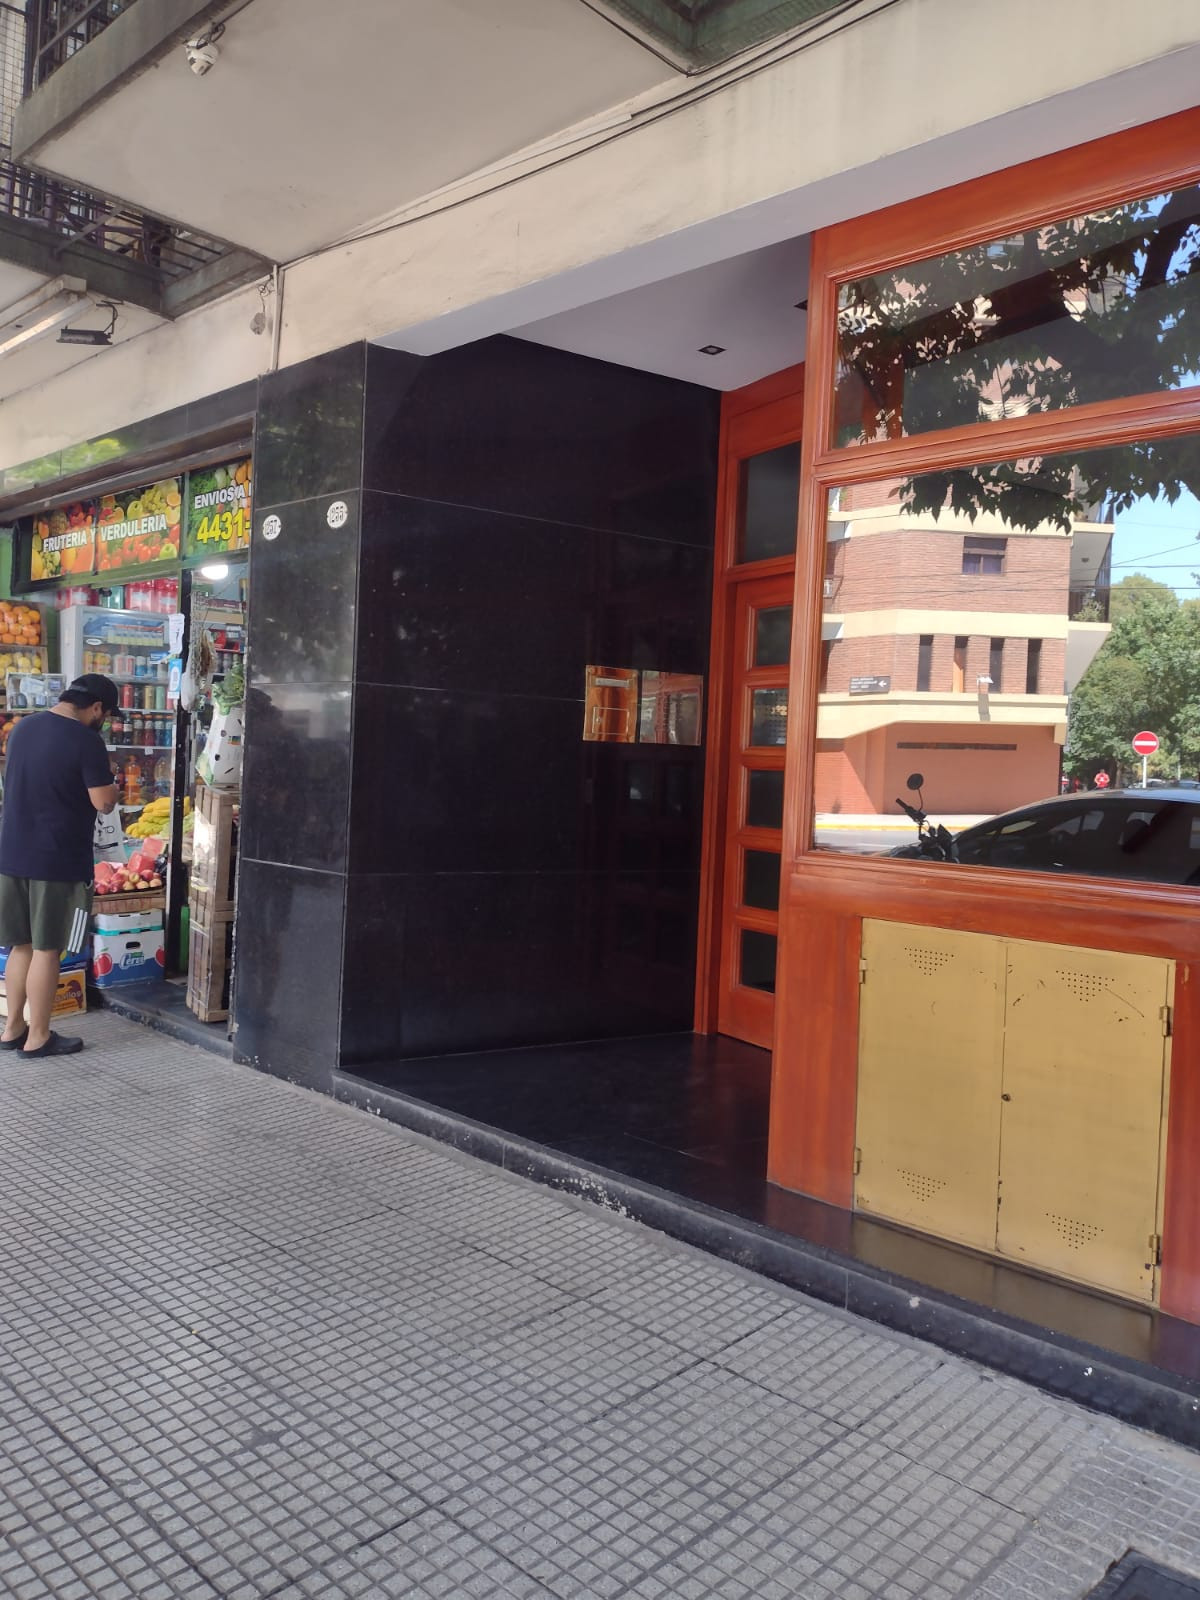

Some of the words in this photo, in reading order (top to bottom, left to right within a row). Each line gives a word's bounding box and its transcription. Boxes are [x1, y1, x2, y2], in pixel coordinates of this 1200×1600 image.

[194, 486, 235, 509] ENVIOS
[236, 484, 246, 499] A
[43, 531, 88, 553] FRUTERIA
[90, 528, 97, 544] Y
[100, 513, 168, 542] VERDULERIA
